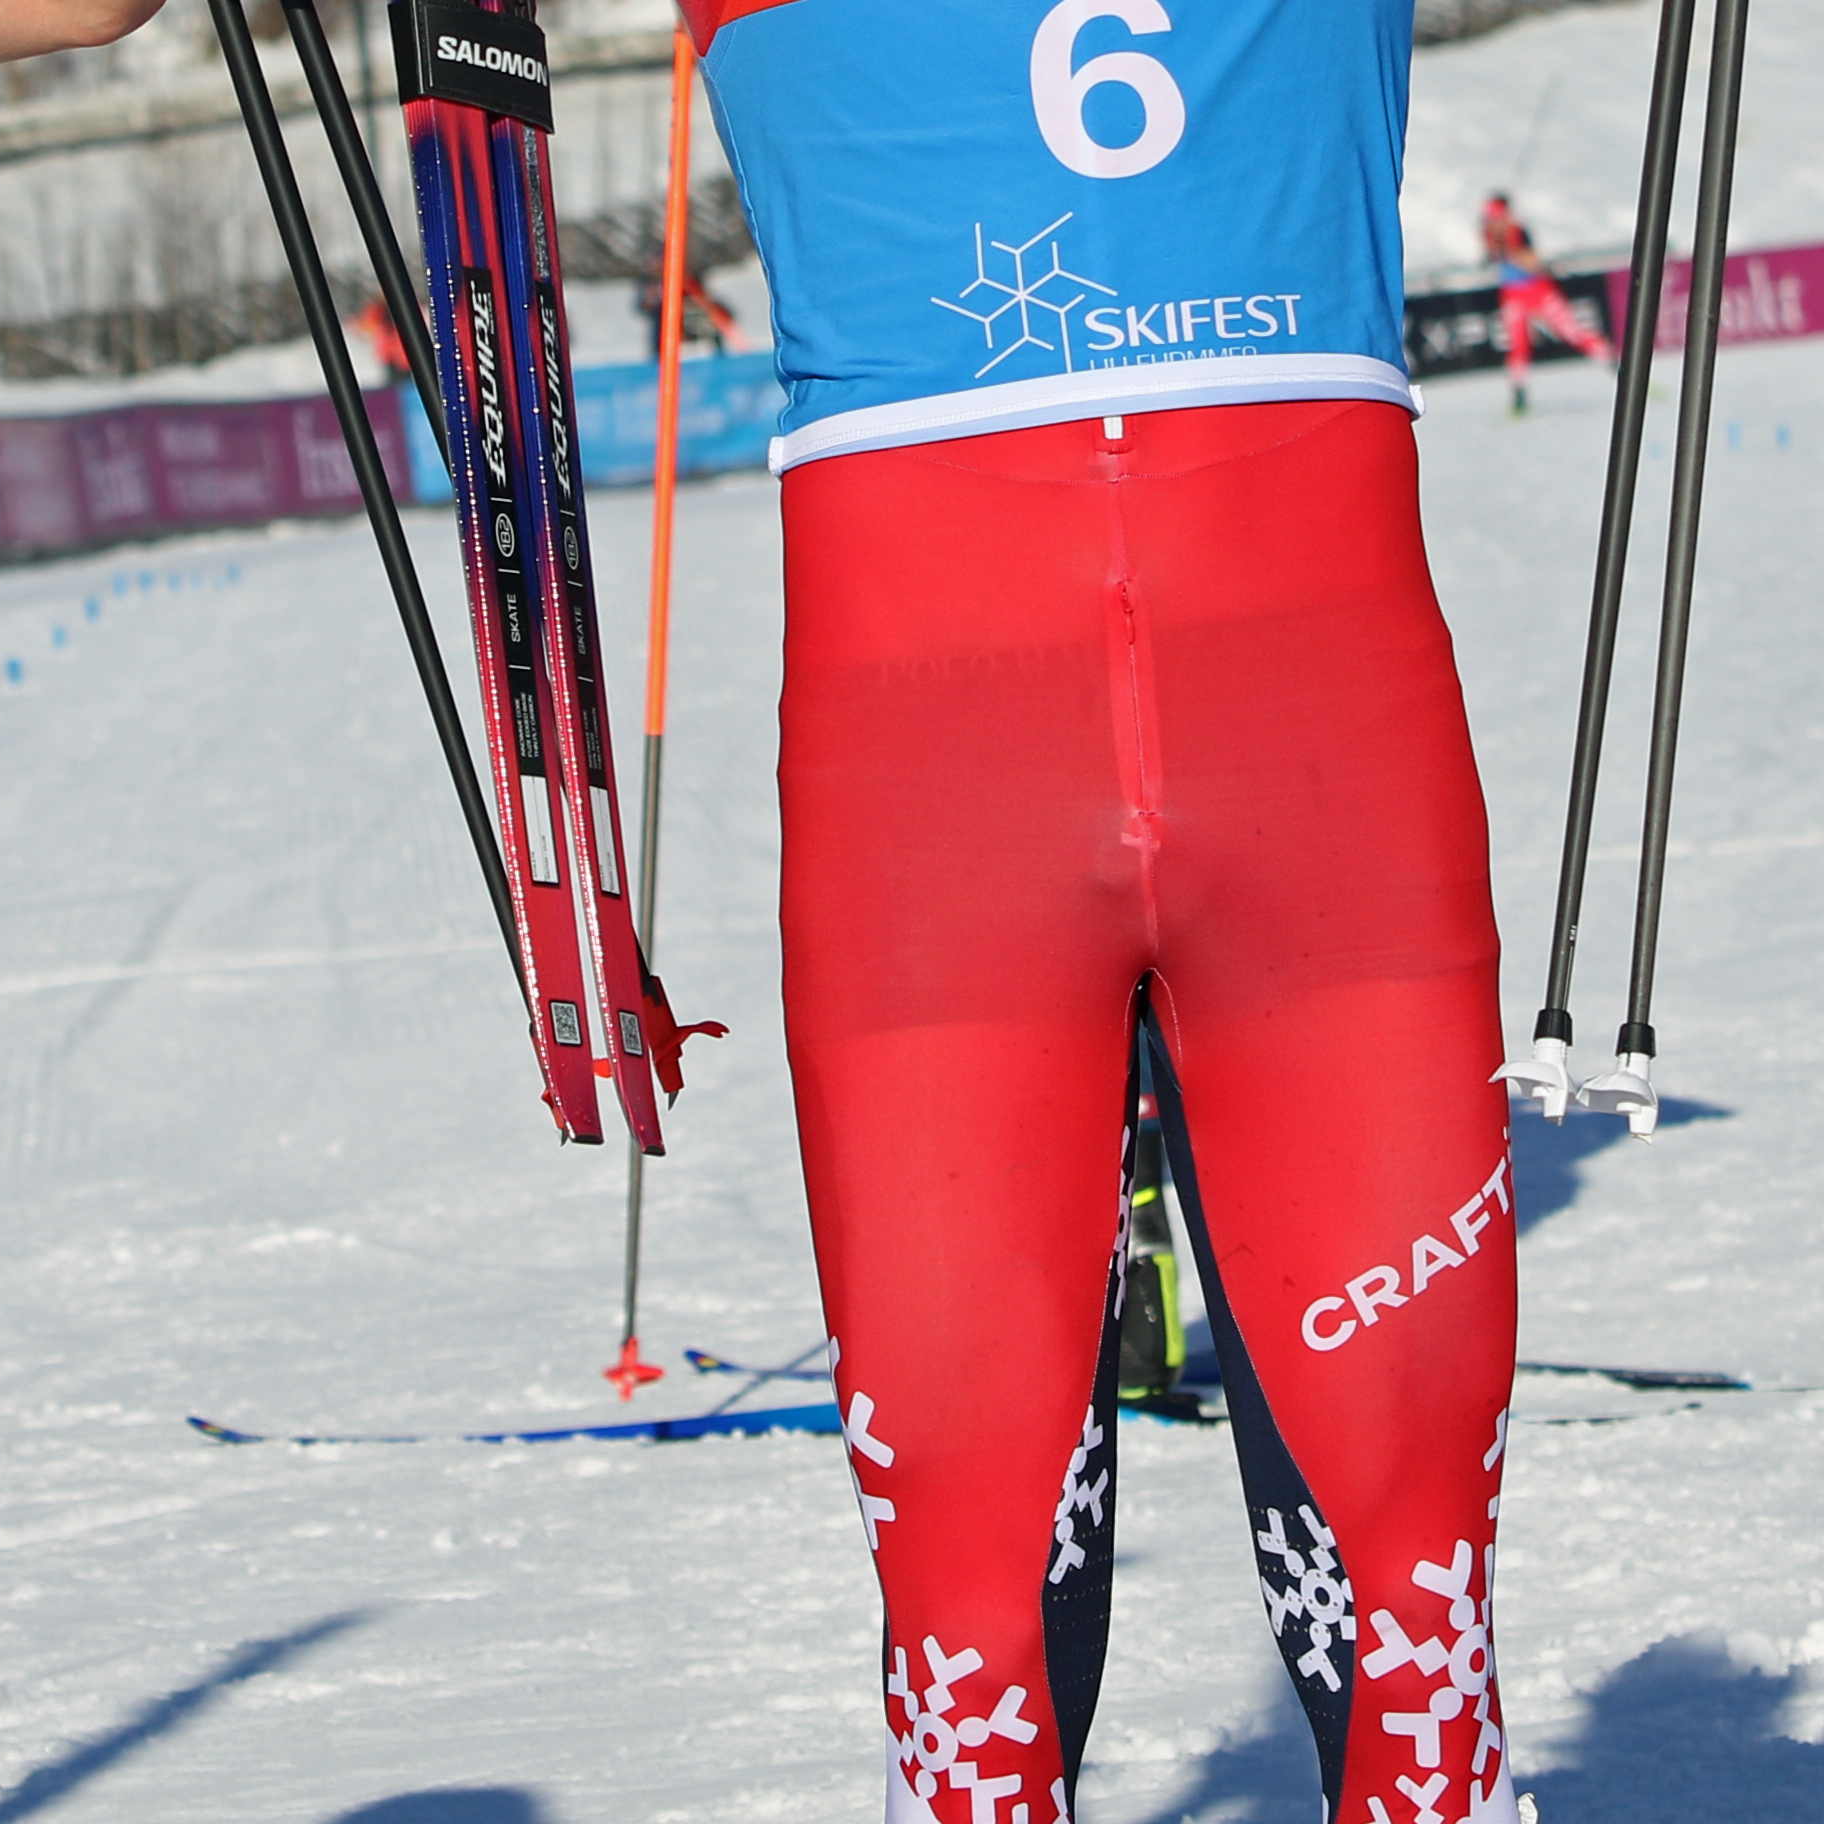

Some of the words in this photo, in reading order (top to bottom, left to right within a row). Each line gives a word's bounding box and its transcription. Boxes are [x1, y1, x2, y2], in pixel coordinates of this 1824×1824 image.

[436, 34, 548, 87] SALOMON
[1085, 293, 1303, 352] SKIFEST
[506, 593, 522, 643] SKATE
[1301, 1158, 1509, 1353] CRAFT
